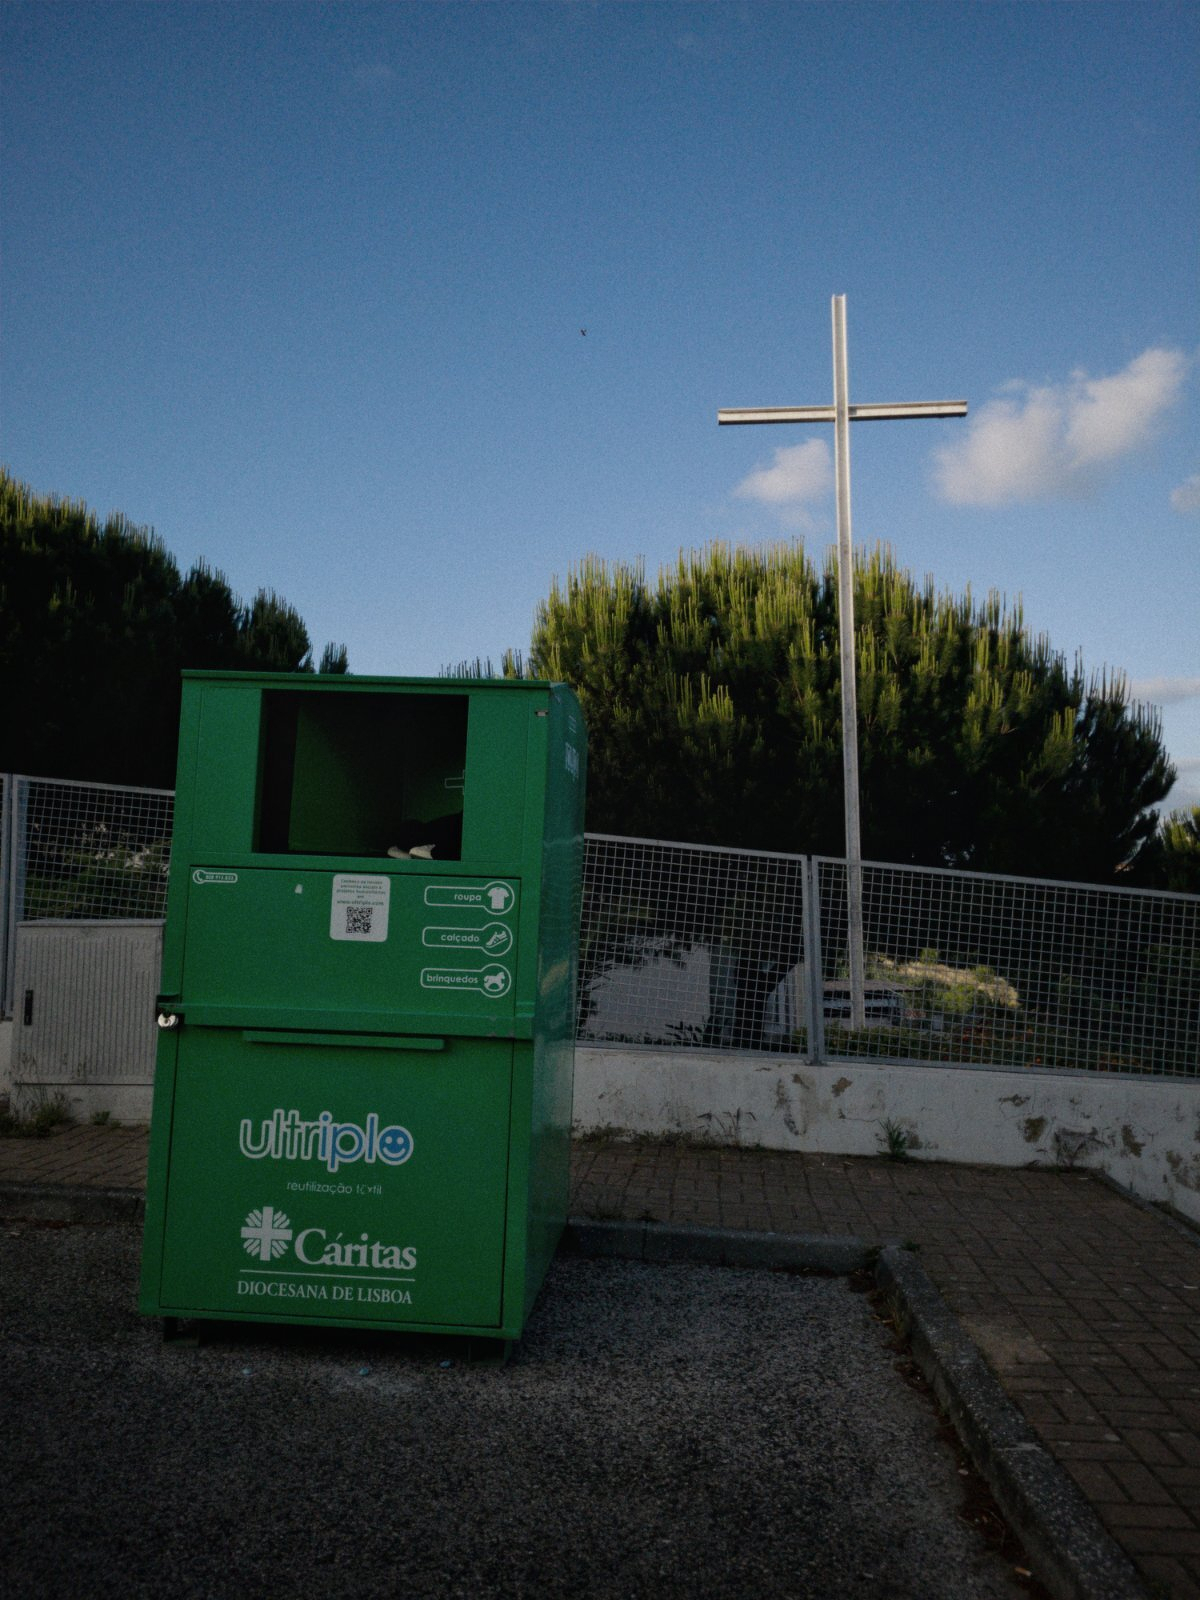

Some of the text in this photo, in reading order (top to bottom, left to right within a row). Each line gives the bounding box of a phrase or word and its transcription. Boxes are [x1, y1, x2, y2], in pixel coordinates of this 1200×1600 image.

[454, 893, 482, 902] roupa
[440, 933, 480, 943] calçado
[426, 974, 479, 984] brinquedos
[240, 1109, 414, 1173] ultriplo
[286, 1181, 352, 1195] reutilização
[294, 1228, 417, 1270] Cáritas
[237, 1280, 412, 1305] DIOCESANA DE LISBOA
